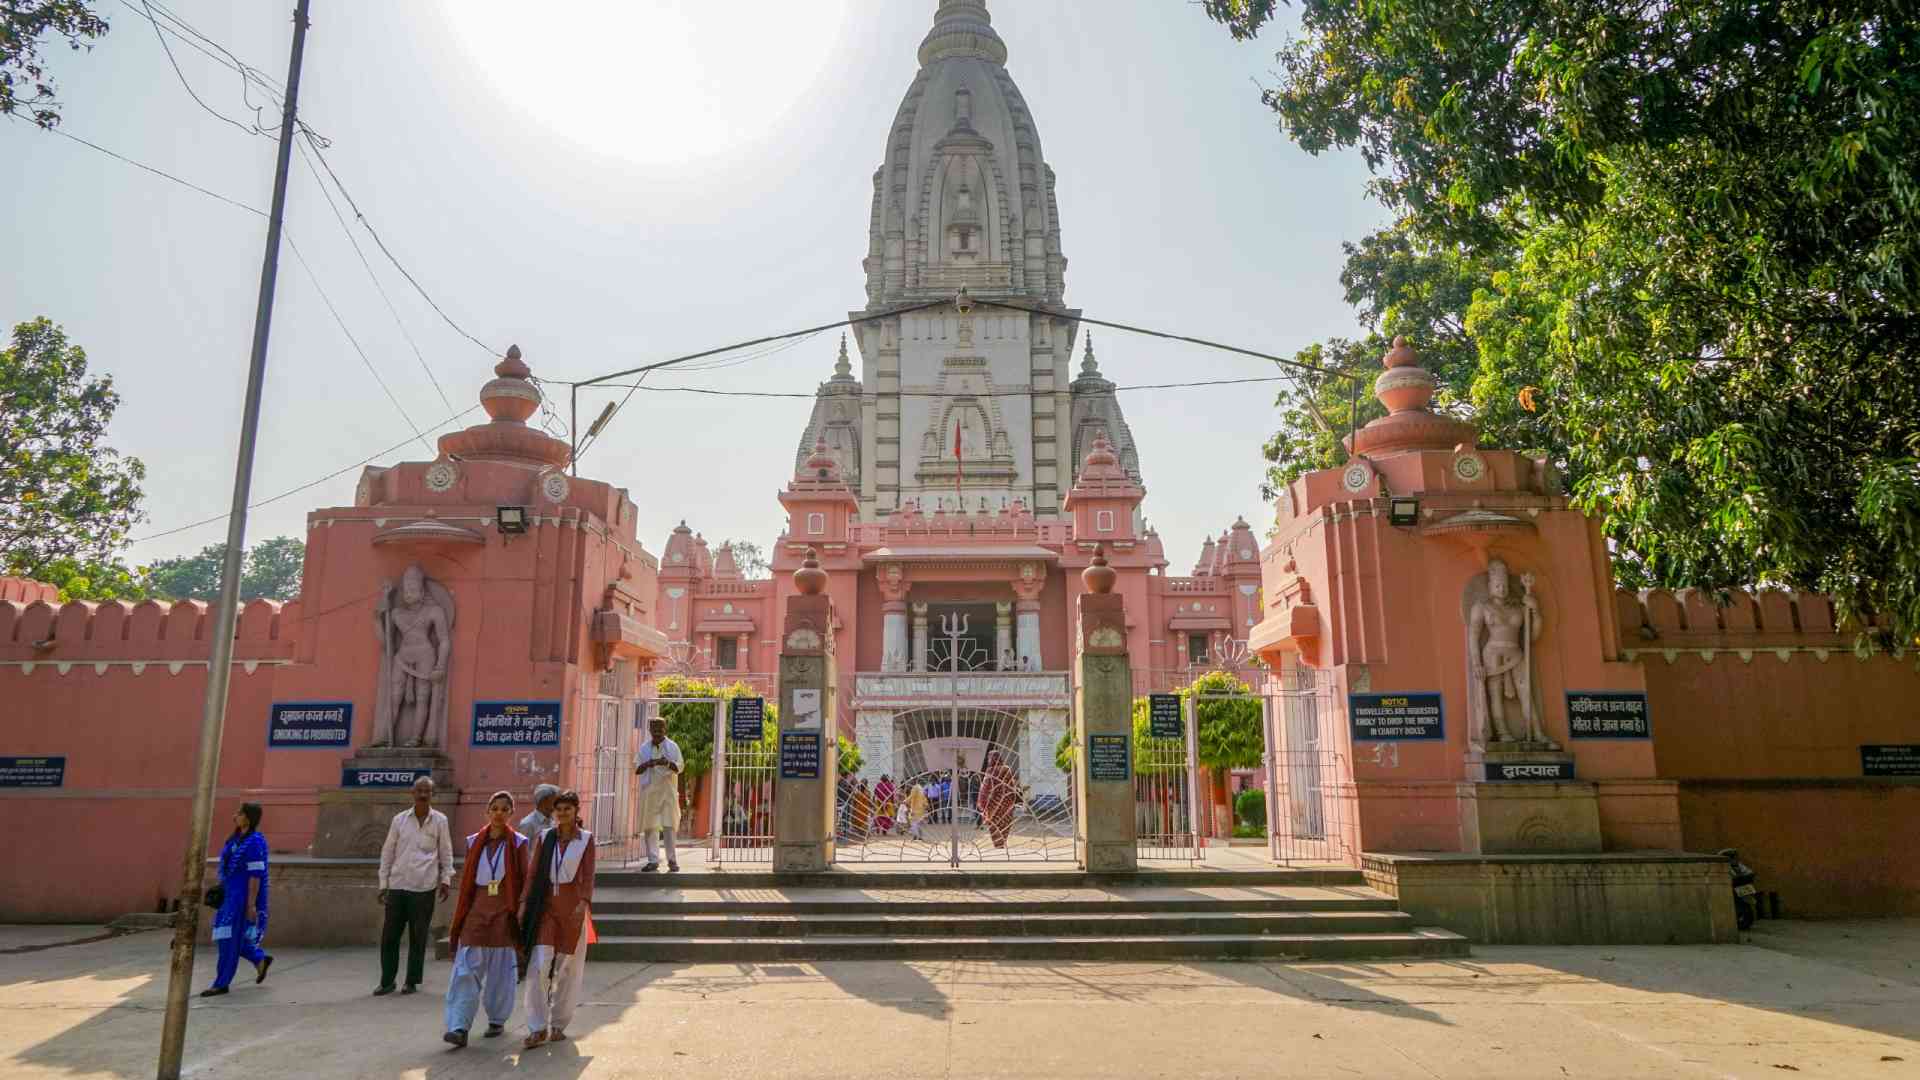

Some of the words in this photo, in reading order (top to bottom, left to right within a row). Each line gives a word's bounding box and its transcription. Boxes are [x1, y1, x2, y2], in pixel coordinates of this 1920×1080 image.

[1381, 698, 1408, 706] NOTICE
[1395, 707, 1406, 715] ARE
[1355, 717, 1376, 726] KINDLY
[1378, 717, 1386, 726] TO
[1387, 717, 1403, 726] DROP
[1404, 717, 1416, 726] THE
[1417, 717, 1438, 726] MONEY
[1572, 716, 1591, 731] भीतर
[1370, 727, 1376, 736] IN
[1378, 727, 1403, 736] CHARITY
[1404, 727, 1425, 736] BOXES
[1502, 765, 1560, 779] द्वारपाल
[358, 772, 415, 784] द्वारपाल
